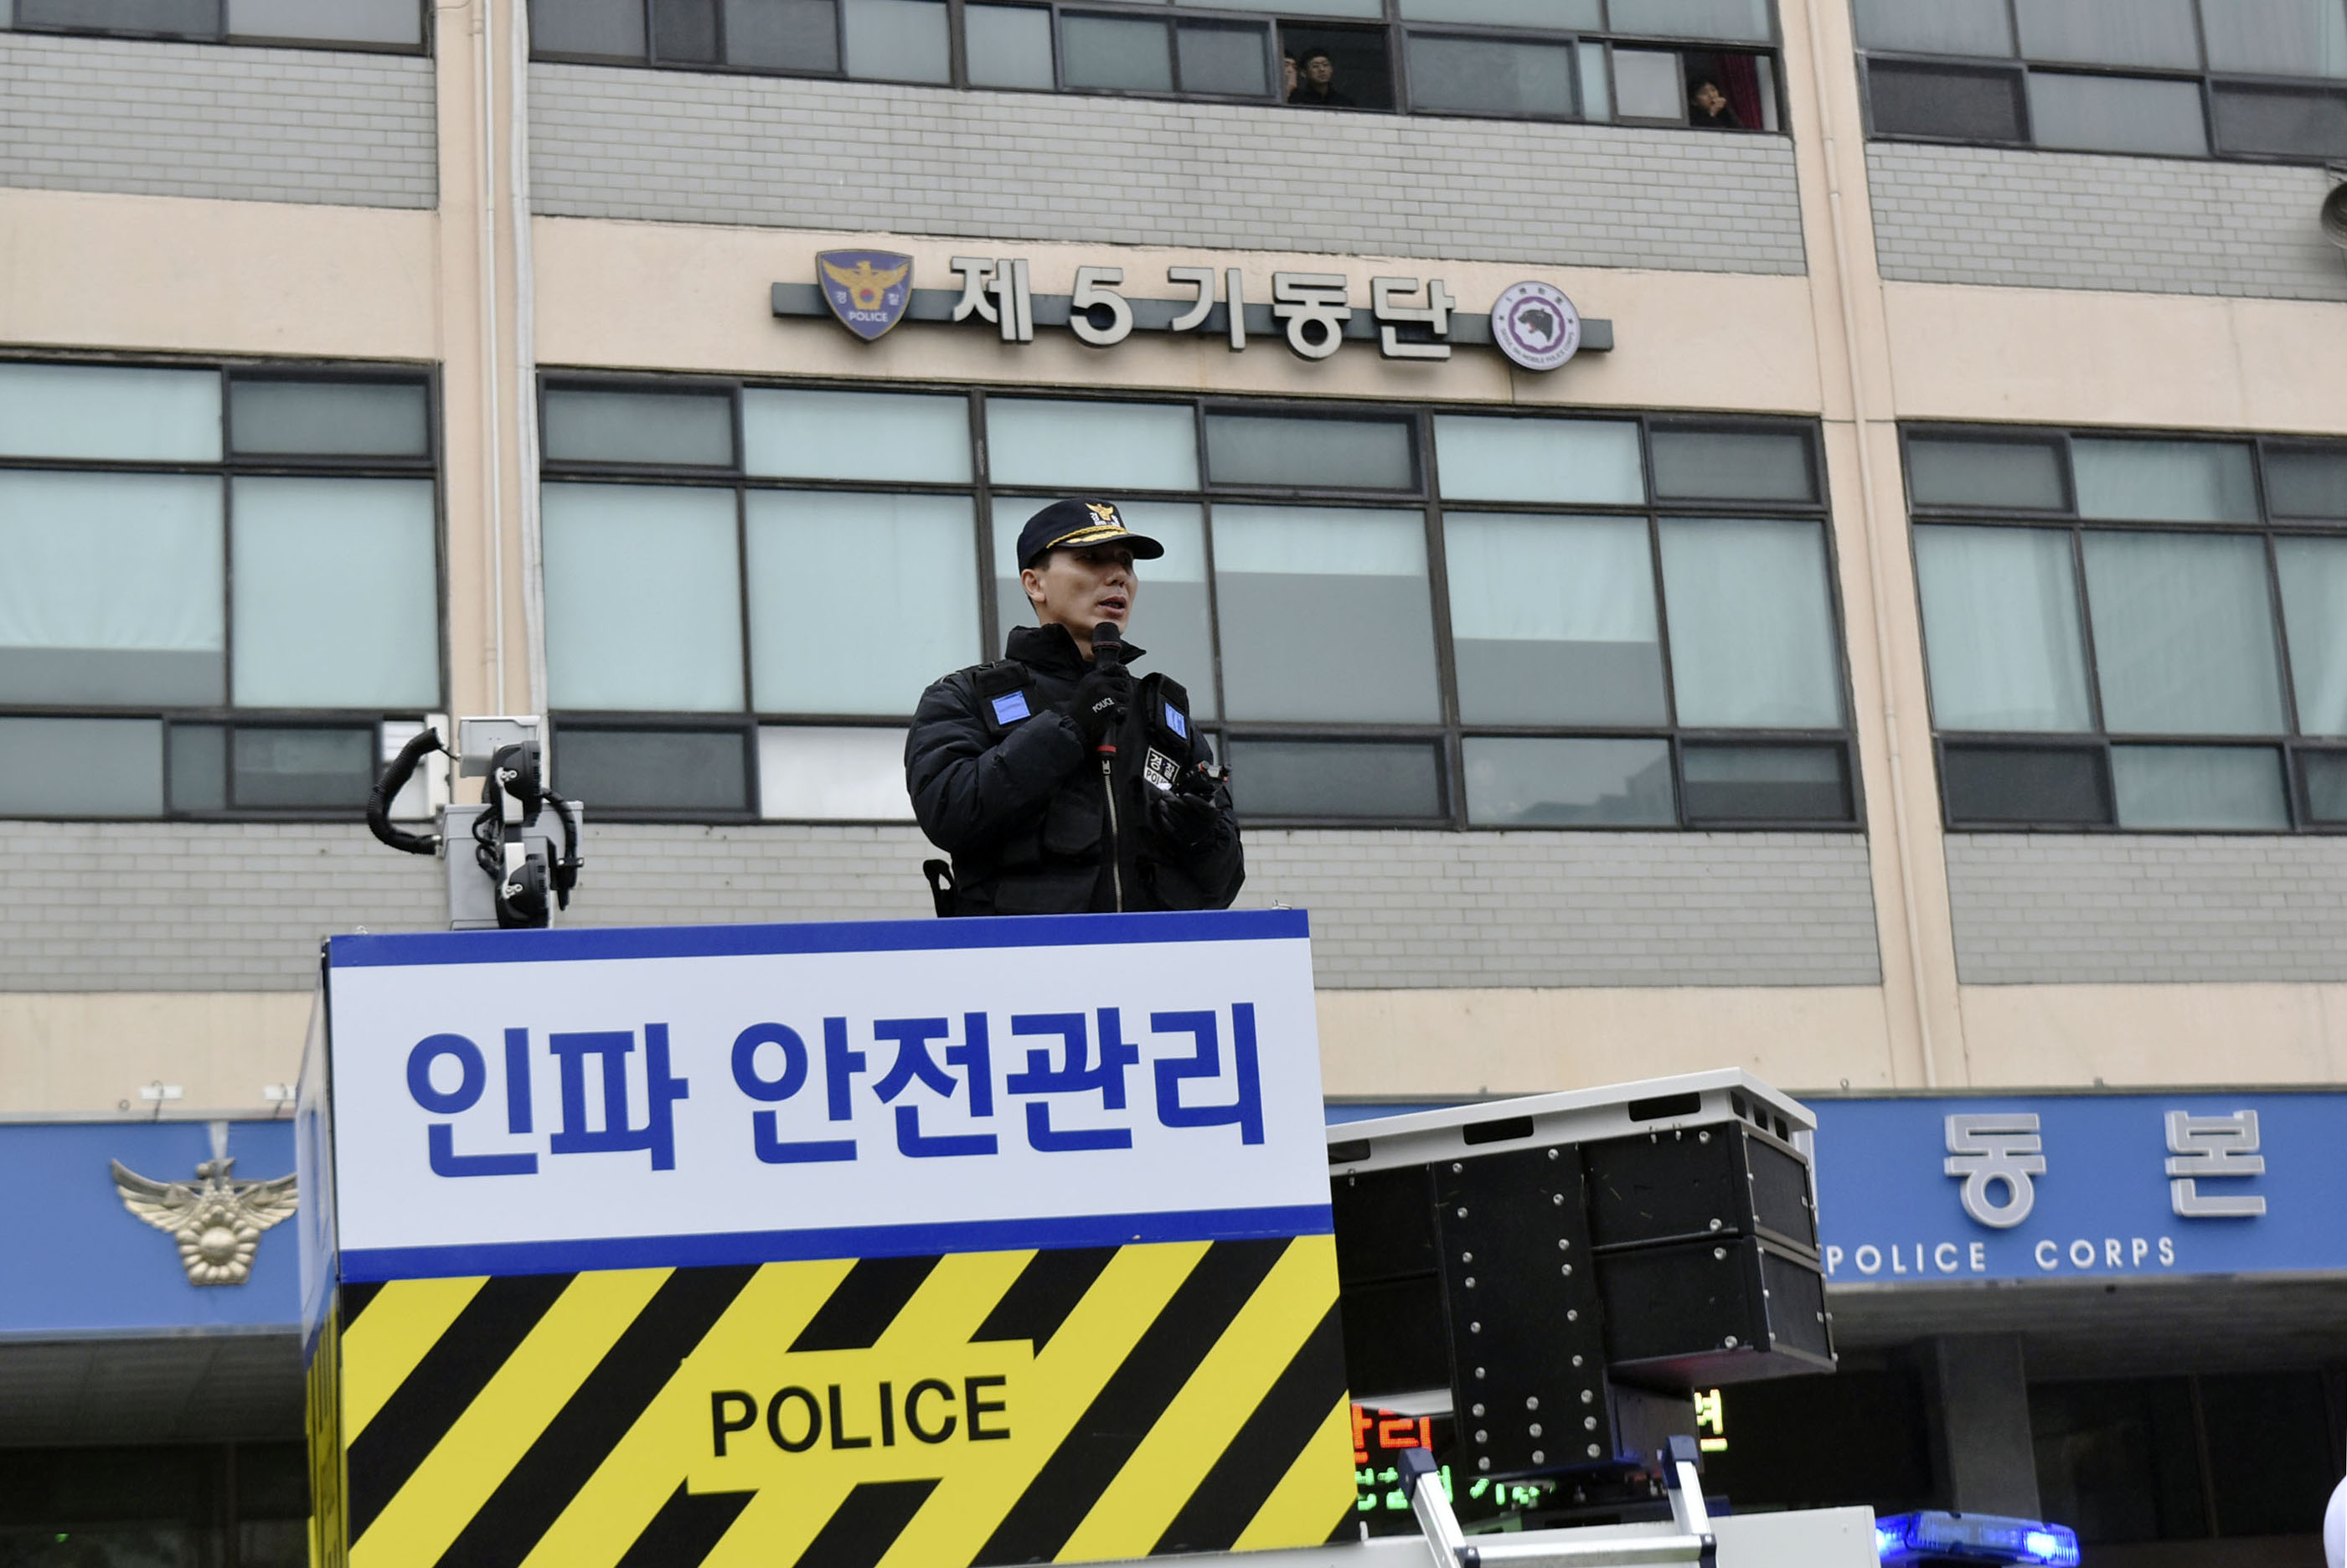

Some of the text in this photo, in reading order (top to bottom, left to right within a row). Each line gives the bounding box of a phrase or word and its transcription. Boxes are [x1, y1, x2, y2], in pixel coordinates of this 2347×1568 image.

[849, 311, 889, 322] POLICE
[1091, 697, 1115, 713] POLICE
[405, 1002, 1266, 1179] 인파 안전관리
[1825, 1235, 2176, 1276] POLICE CORPS
[710, 1375, 1012, 1458] POLICE
